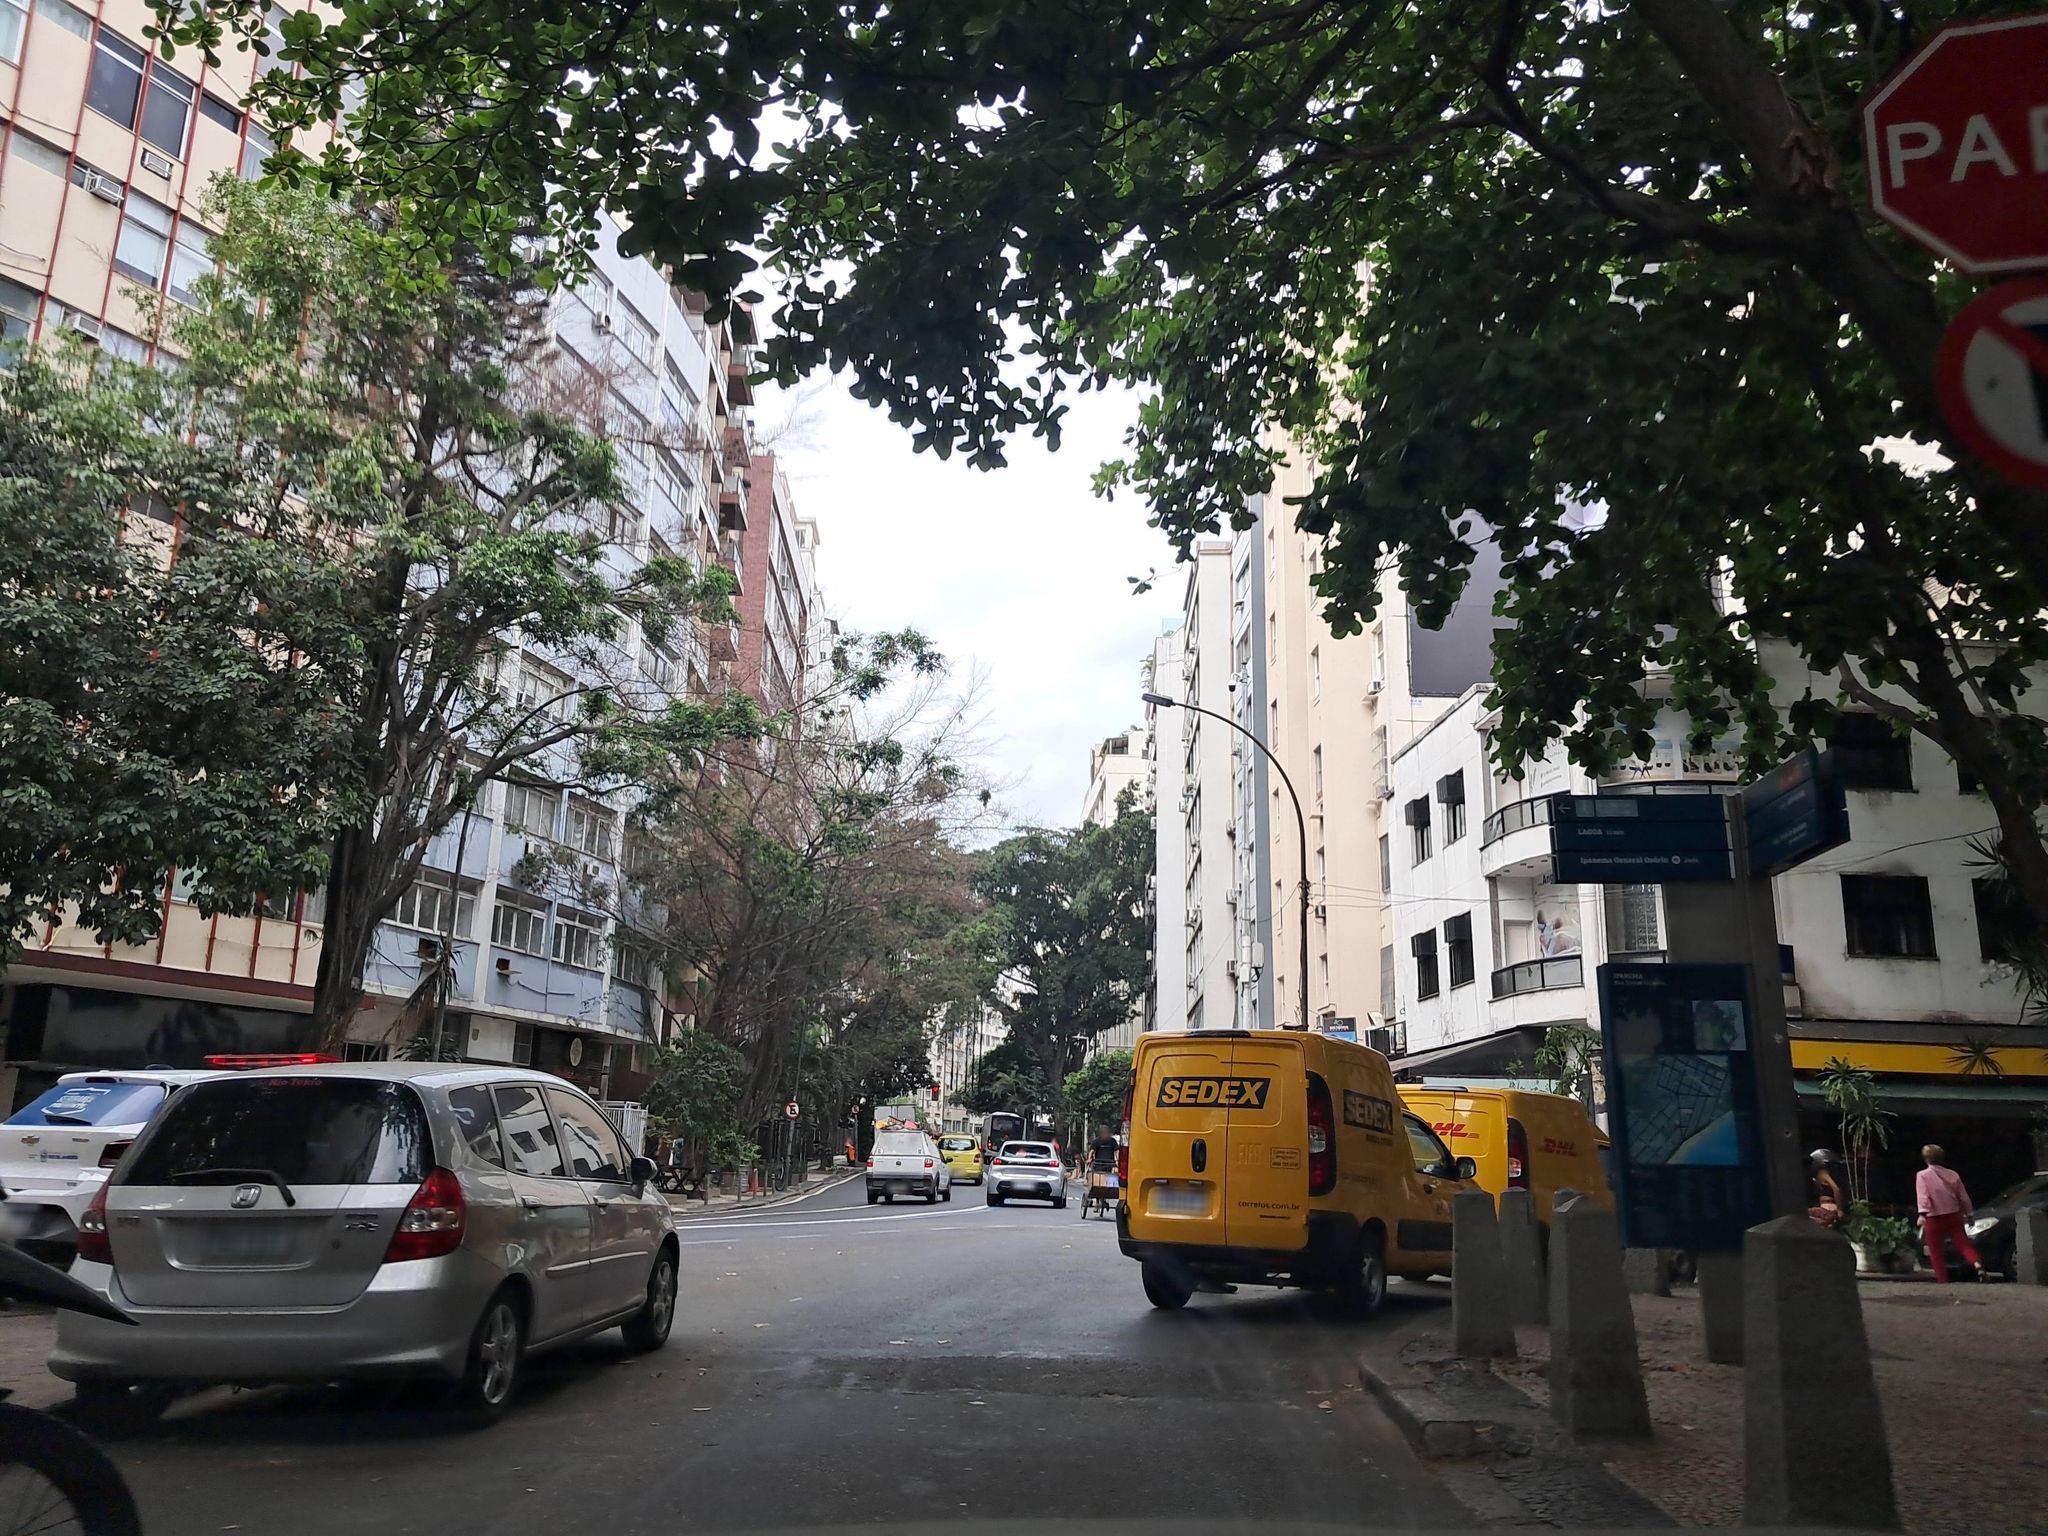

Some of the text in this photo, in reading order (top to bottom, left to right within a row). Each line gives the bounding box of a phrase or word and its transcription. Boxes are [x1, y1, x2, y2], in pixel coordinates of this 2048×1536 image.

[1580, 857, 1613, 865] Ipanema
[1614, 856, 1643, 864] General
[1161, 1080, 1265, 1106] SEDEX
[1344, 1094, 1393, 1131] SEDEX
[1237, 1200, 1301, 1211] correios.com.br
